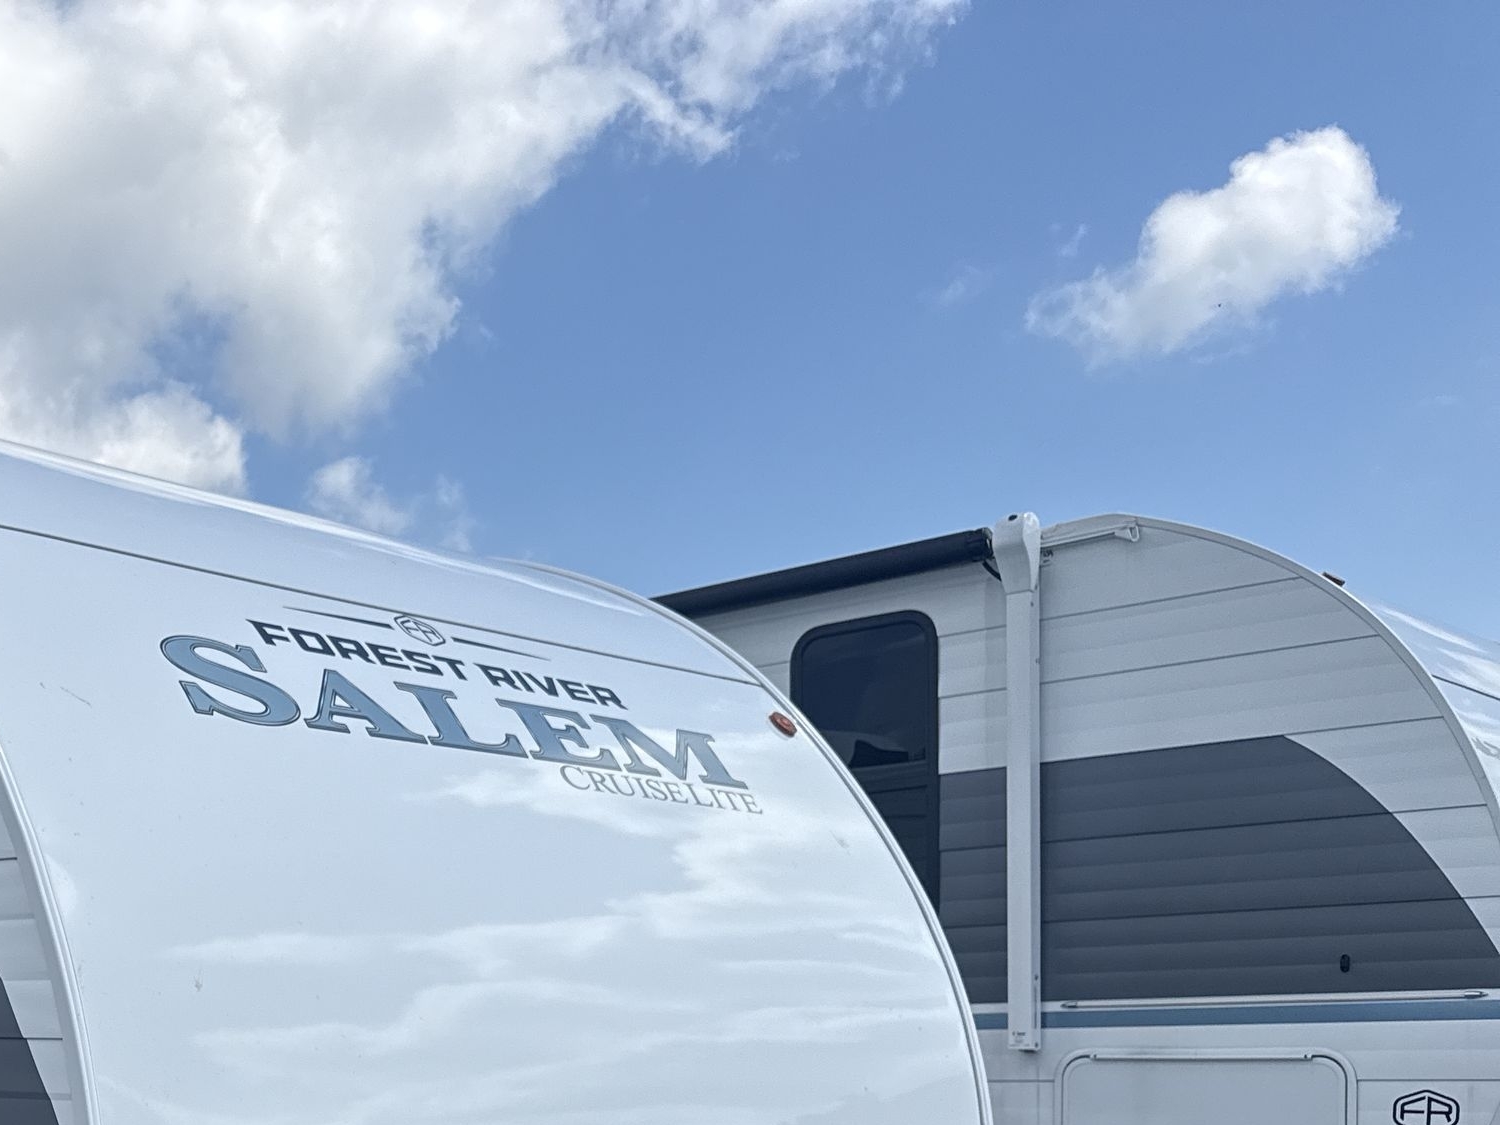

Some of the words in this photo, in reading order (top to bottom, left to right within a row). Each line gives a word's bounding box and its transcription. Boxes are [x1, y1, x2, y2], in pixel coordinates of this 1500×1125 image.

[159, 634, 749, 790] SALEM
[246, 618, 466, 681] FOREST
[479, 663, 628, 711] RIVER
